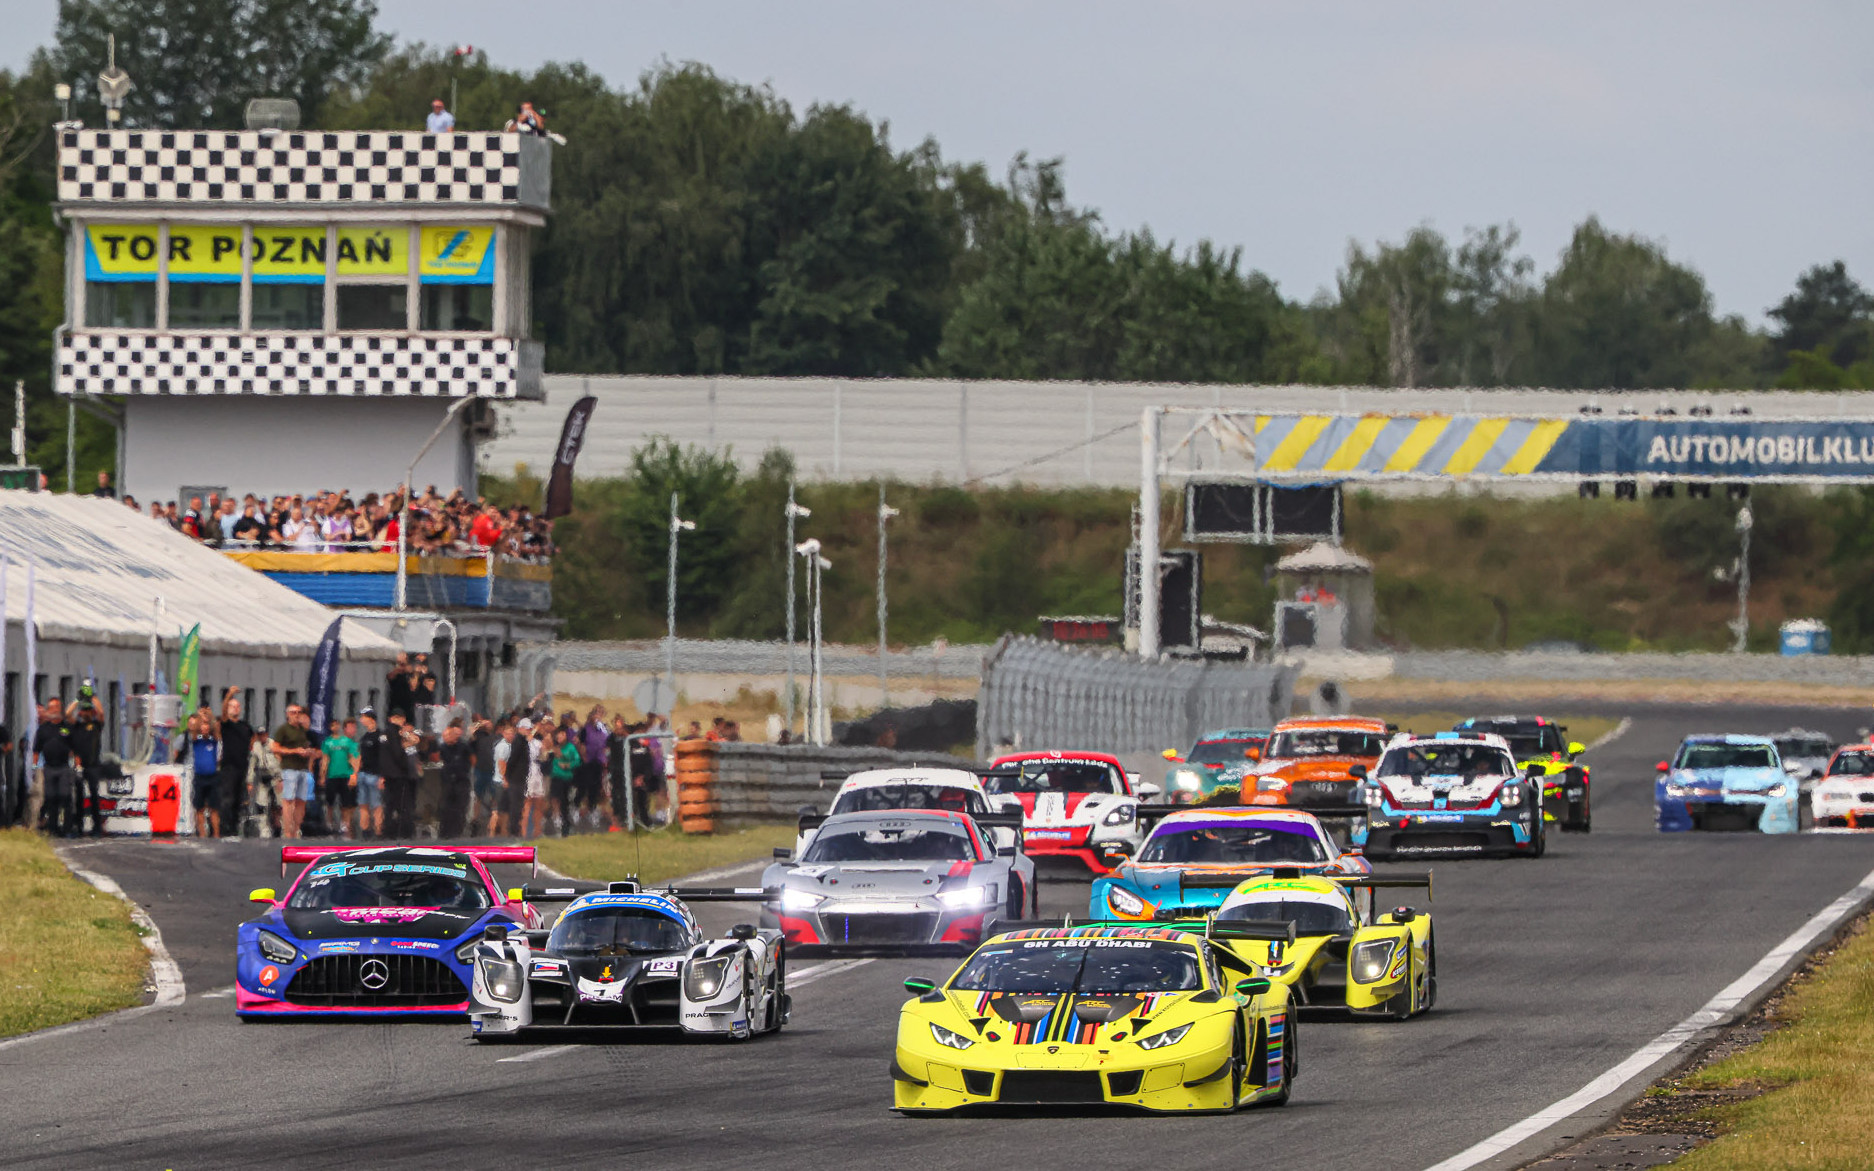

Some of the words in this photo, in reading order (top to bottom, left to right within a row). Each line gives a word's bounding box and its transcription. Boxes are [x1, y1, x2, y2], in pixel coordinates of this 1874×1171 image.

[101, 235, 192, 262] TOR
[211, 231, 392, 263] POZNAŃ
[150, 784, 176, 802] 14
[591, 896, 679, 914] MICHELIN
[1052, 940, 1090, 948] ABU
[1095, 940, 1153, 949] DHABI
[653, 961, 676, 970] P3
[263, 969, 273, 981] A
